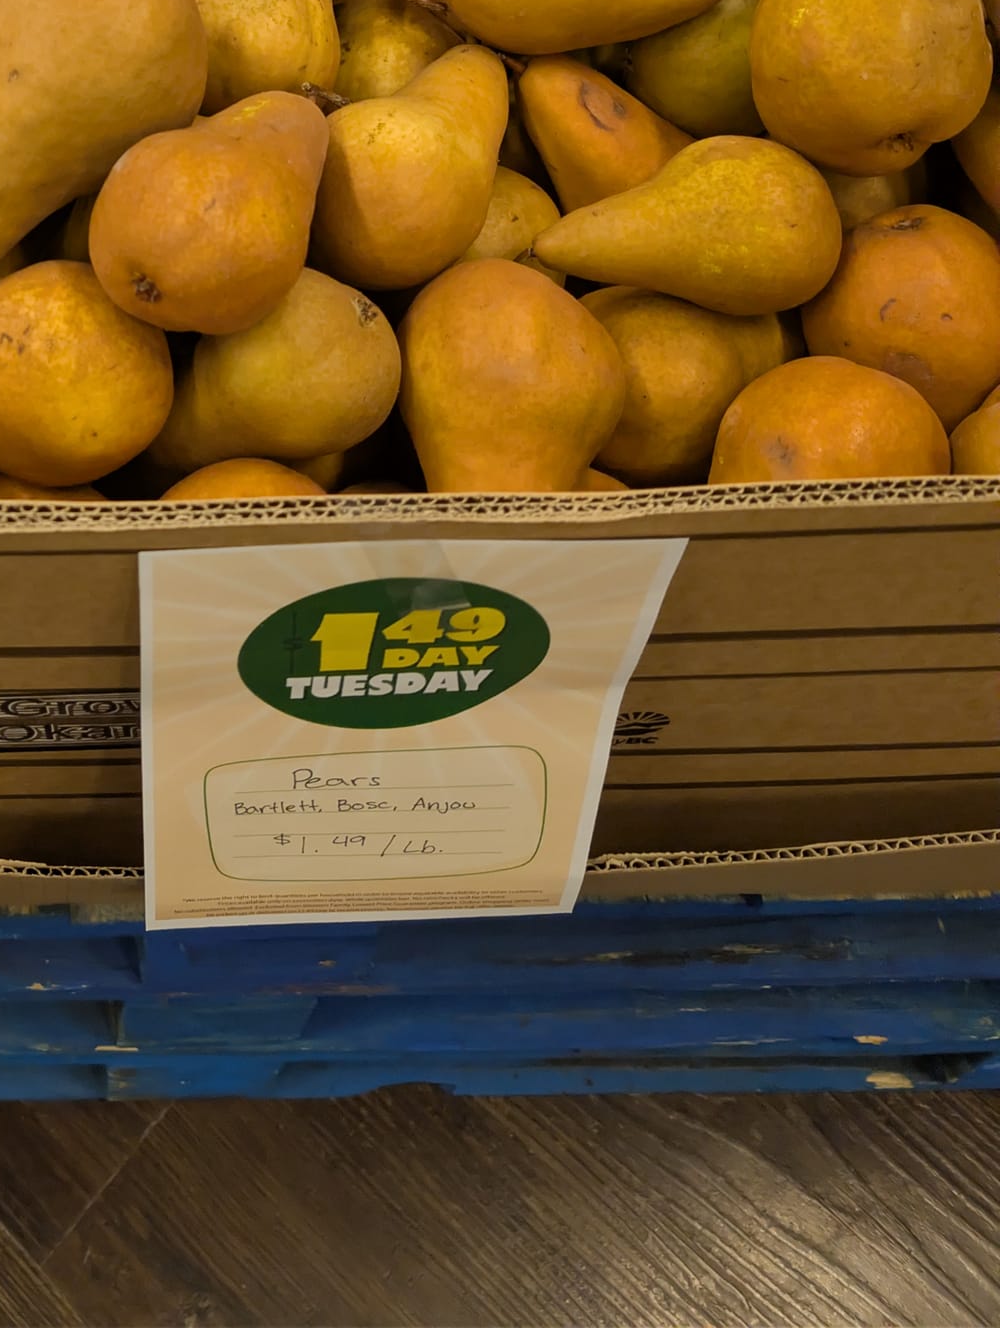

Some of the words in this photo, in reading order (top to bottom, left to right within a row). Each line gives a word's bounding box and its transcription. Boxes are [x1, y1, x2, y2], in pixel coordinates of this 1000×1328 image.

[382, 645, 500, 669] DAY
[285, 669, 494, 700] TUESDAY
[292, 768, 381, 790] Pears
[234, 801, 323, 816] Bartlett,
[337, 799, 398, 813] Bosc,
[411, 797, 476, 815] Anjou
